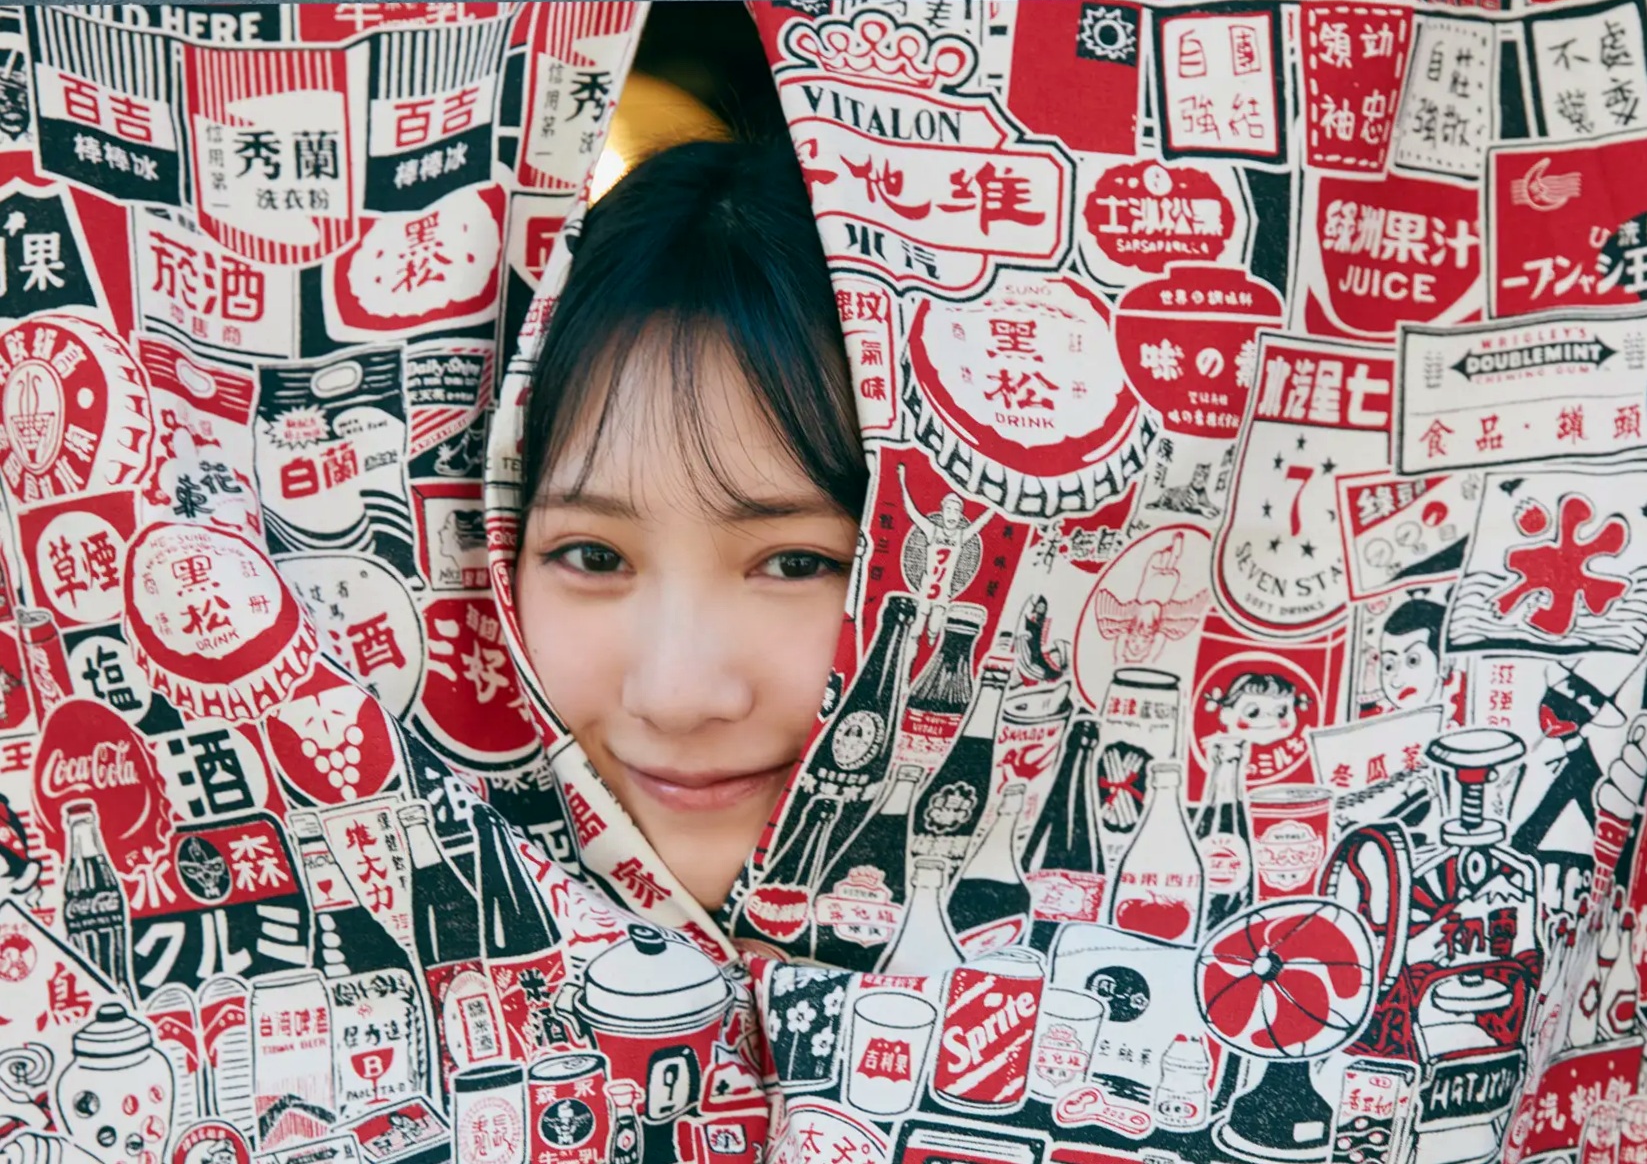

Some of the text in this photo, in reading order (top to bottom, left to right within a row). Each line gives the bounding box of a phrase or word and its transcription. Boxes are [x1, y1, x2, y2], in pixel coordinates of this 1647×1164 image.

[801, 85, 962, 143] VITALON
[1338, 264, 1437, 303] JUICE
[1465, 343, 1603, 374] DOUBLEMINT
[994, 411, 1056, 430] DRINK
[1236, 540, 1345, 599] SEVEN STA
[41, 740, 141, 798] Coca-Cola
[942, 991, 1037, 1074] Sprite
